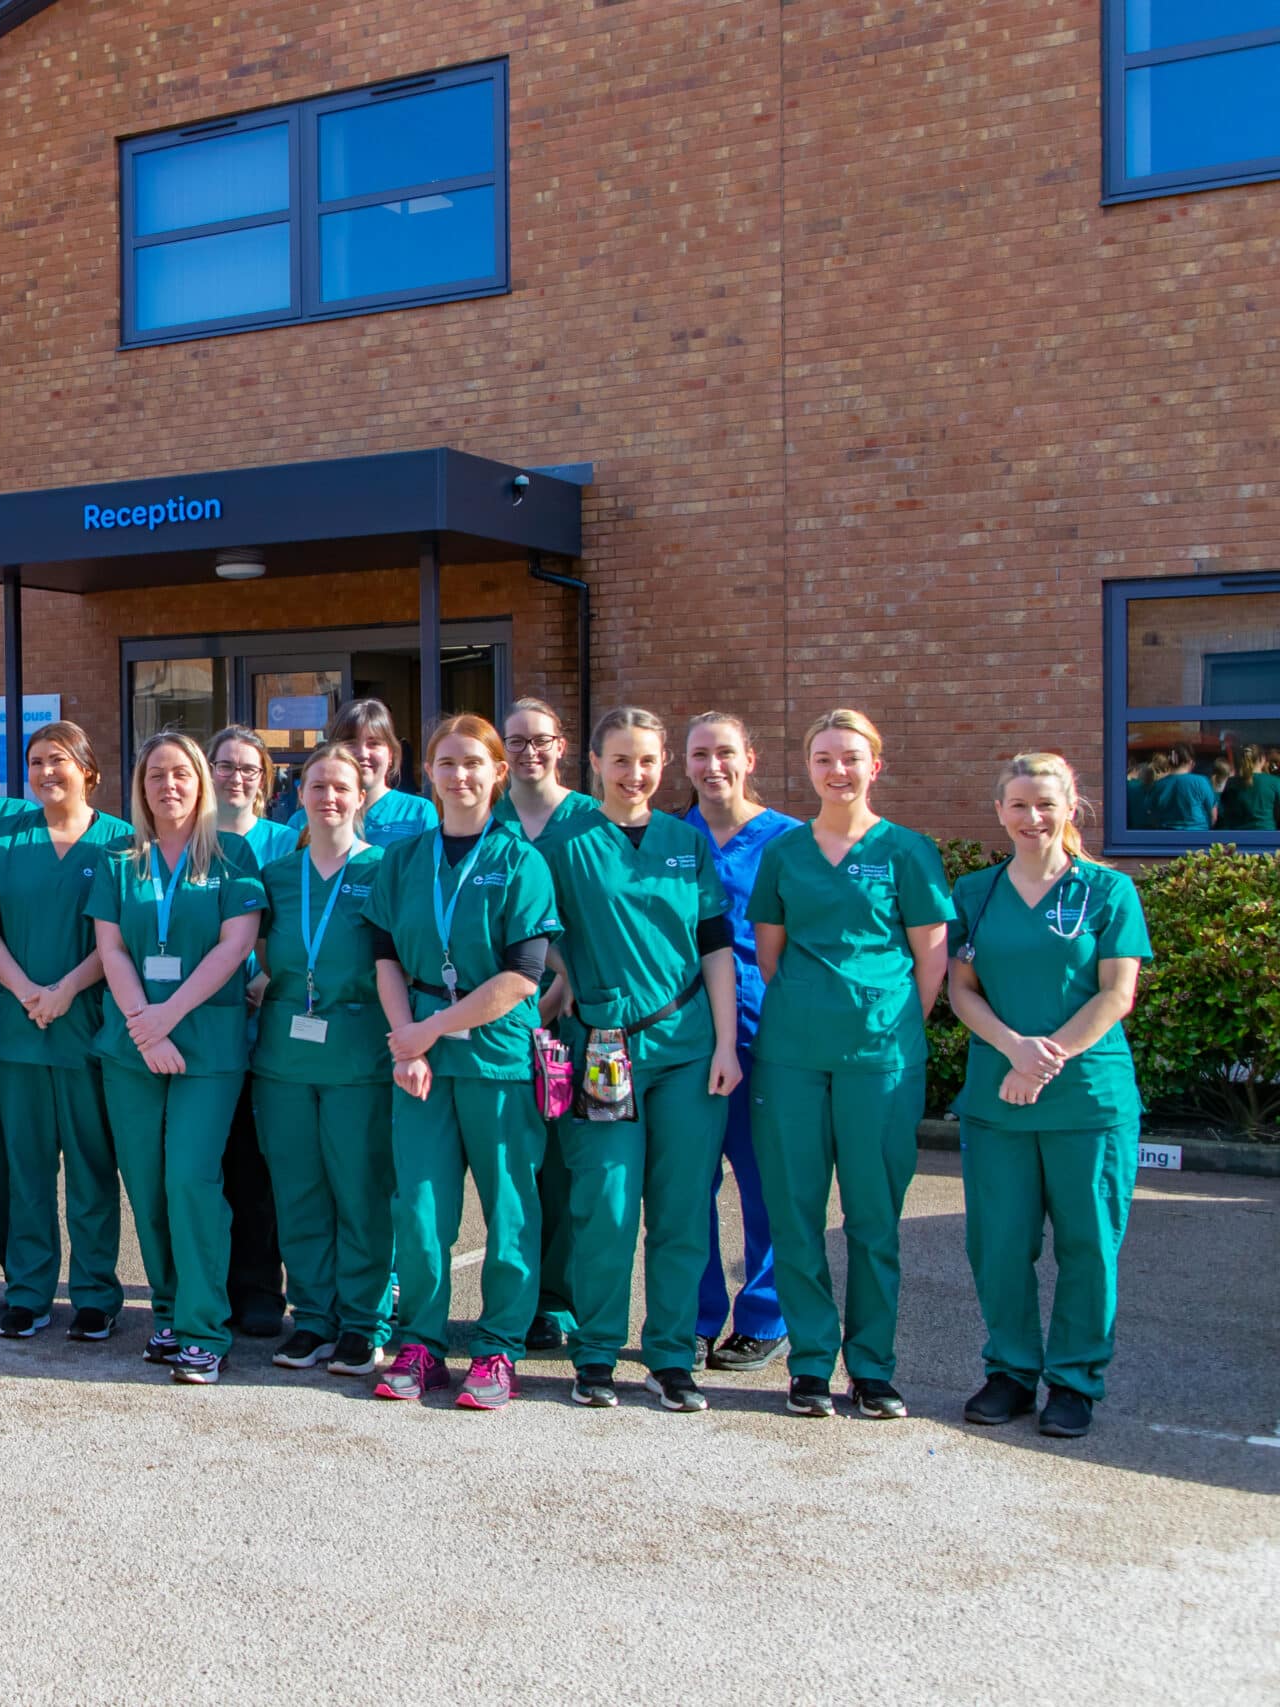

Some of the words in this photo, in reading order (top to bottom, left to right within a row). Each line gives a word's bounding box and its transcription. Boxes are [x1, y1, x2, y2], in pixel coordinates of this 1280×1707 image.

[83, 495, 221, 531] Reception
[23, 711, 52, 722] ouse
[1140, 1148, 1168, 1167] ing
